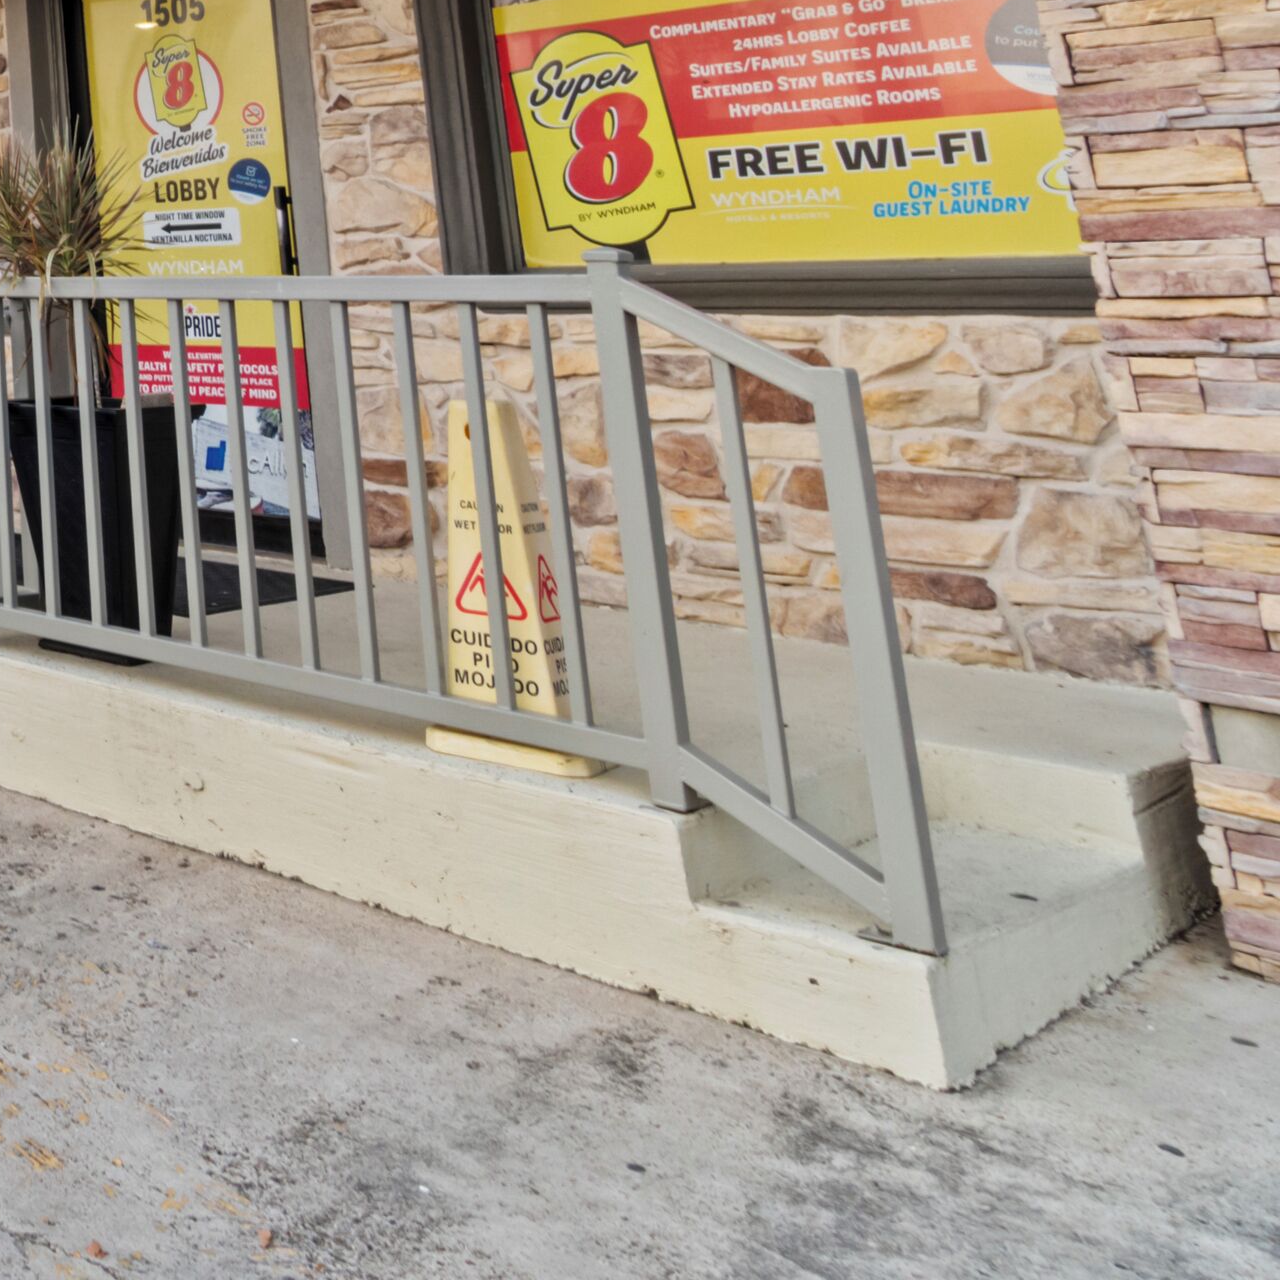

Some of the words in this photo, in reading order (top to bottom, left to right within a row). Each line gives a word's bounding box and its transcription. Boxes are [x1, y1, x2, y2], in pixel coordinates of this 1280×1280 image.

[650, 12, 776, 39] COMPLIMENTARY
[842, 3, 854, 15] &
[1014, 24, 1040, 36] Cou
[733, 34, 784, 51] 24HRS
[787, 27, 839, 44] LOBBY
[844, 19, 911, 38] COFFEE
[152, 47, 190, 74] Super
[689, 53, 807, 78] SUITES/FAMILY
[811, 46, 872, 65] SUITES
[876, 36, 972, 58] AVAILABLE
[163, 61, 195, 110] 8
[529, 60, 638, 121] Super
[692, 80, 774, 100] EXTENDED
[777, 75, 817, 91] STAY
[822, 70, 877, 87] RATES
[881, 59, 977, 81] AVAILABLE
[728, 94, 873, 118] HYPOALLERGENIC
[876, 87, 941, 105] ROOMS
[150, 128, 213, 155] Welcome
[563, 92, 654, 205] 8
[142, 143, 226, 178] Bienvenidos
[707, 142, 825, 179] FREE
[835, 130, 988, 170] WI-FI
[154, 178, 220, 203] LOBBY
[710, 186, 842, 208] WYNDHAM
[908, 180, 992, 199] ON-SITE
[155, 212, 175, 221] NIGHT
[177, 211, 193, 220] TIME
[195, 210, 225, 219] WINDOW
[578, 212, 592, 222] BY
[597, 202, 657, 219] WYNDHAM
[873, 201, 931, 218] GUEST
[939, 197, 1030, 215] LAUNDRY
[152, 234, 193, 245] VENTANILLA
[195, 233, 233, 243] NOCTURNA
[147, 259, 244, 275] WYNDHAM
[185, 315, 222, 338] PRIDE
[138, 361, 167, 371] EALTH
[187, 362, 215, 374] AFETY
[218, 363, 278, 376] PTOCOLS
[198, 386, 225, 397] PEAC
[249, 388, 278, 400] MIND
[249, 378, 274, 387] PLACE
[460, 500, 504, 513] CAUN
[454, 519, 476, 530] WET
[451, 628, 538, 656] CUIDDO
[473, 652, 519, 675] PIO
[454, 668, 539, 697] MOJDO
